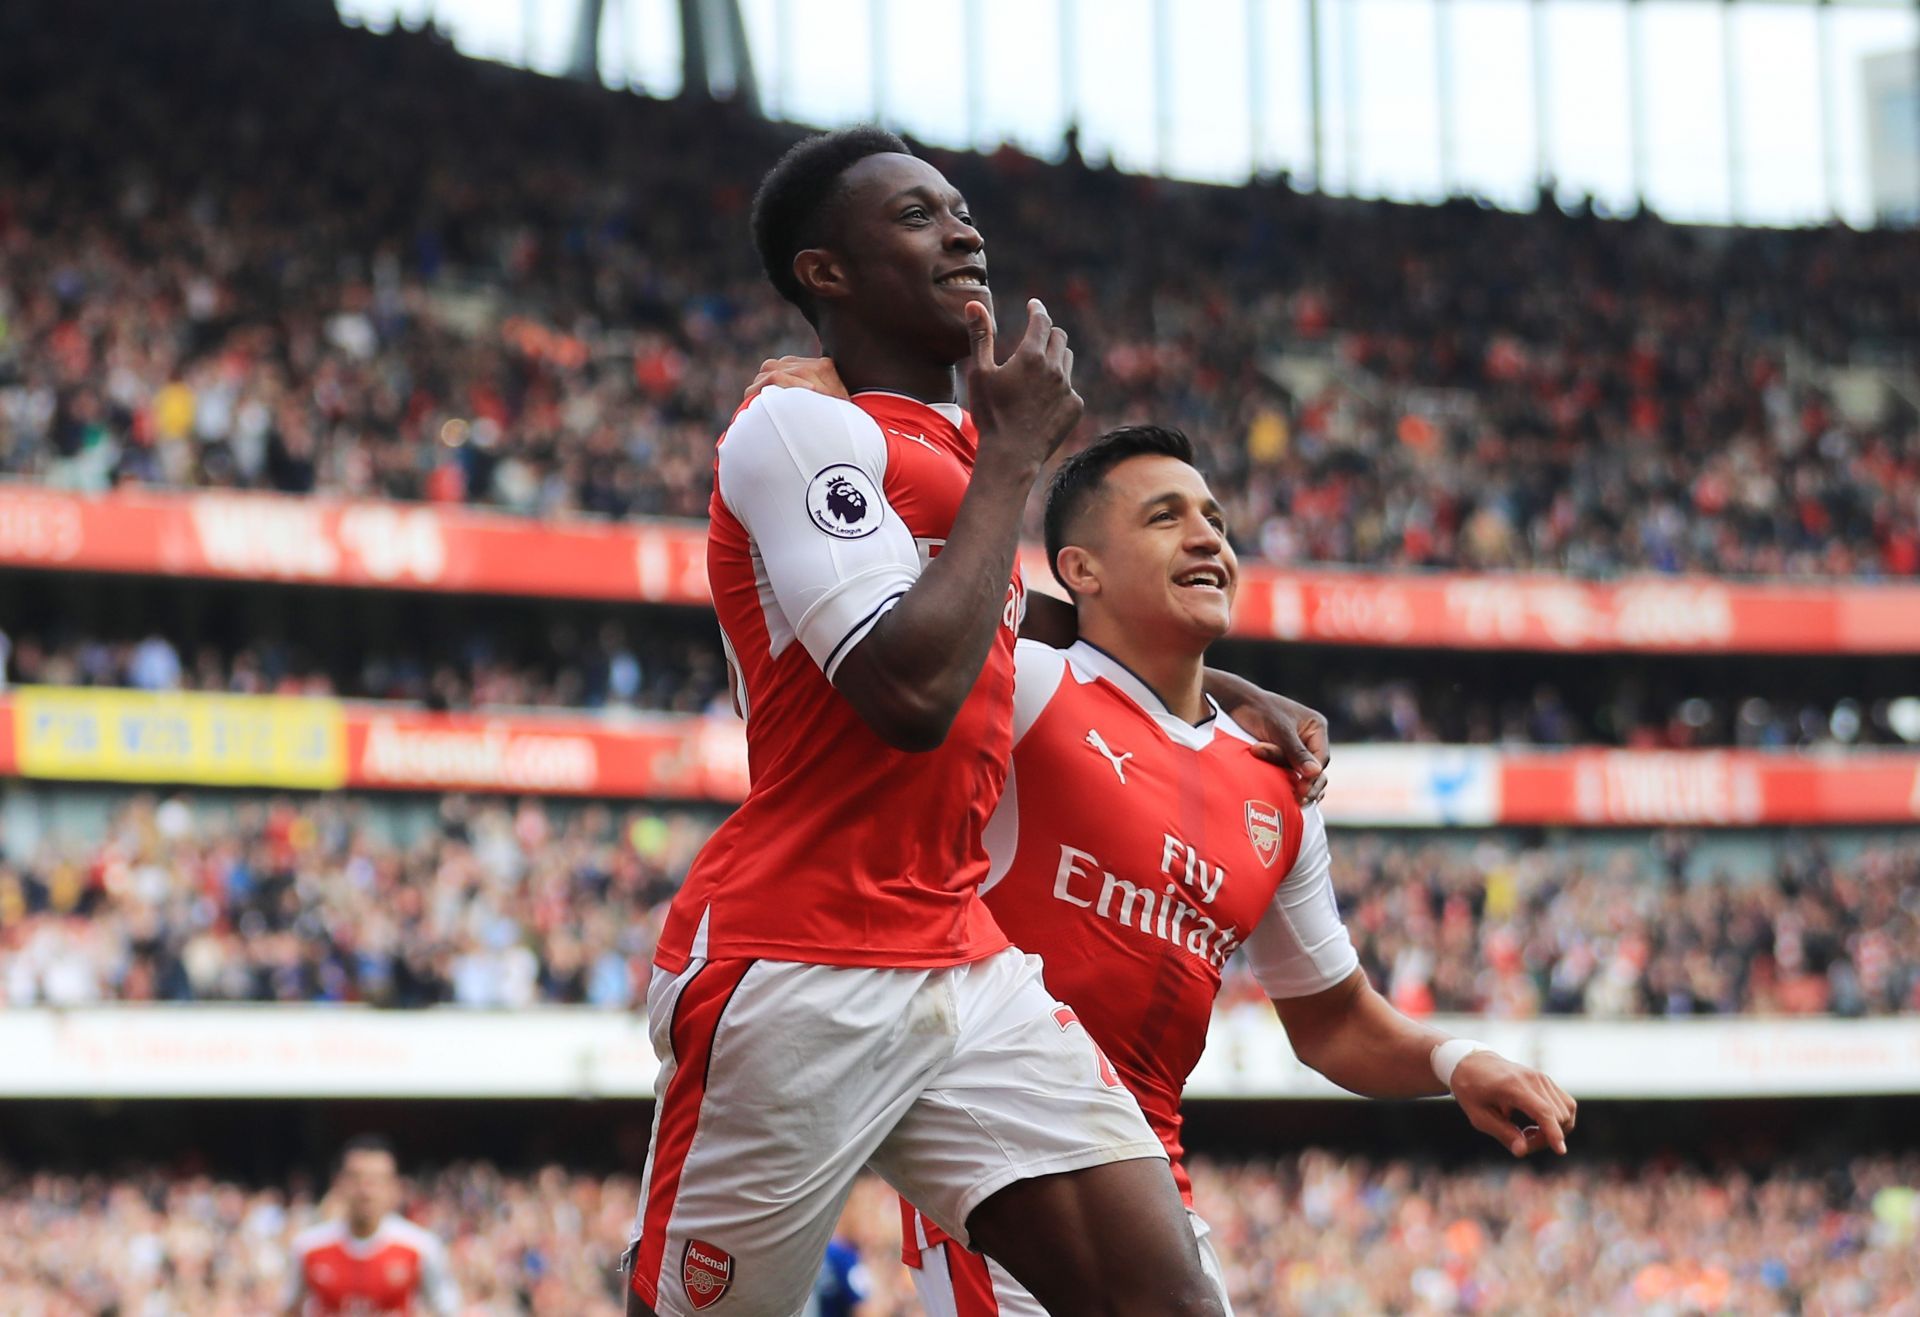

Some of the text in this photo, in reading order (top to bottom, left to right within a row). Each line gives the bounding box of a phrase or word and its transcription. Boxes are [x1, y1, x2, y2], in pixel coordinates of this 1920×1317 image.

[815, 509, 862, 536] Premier League
[361, 715, 598, 791] Arsenal.com
[1249, 808, 1278, 827] Arsenal
[1160, 832, 1225, 904] Fly
[1052, 843, 1240, 973] Emirate
[689, 1247, 728, 1272] Arsenal
